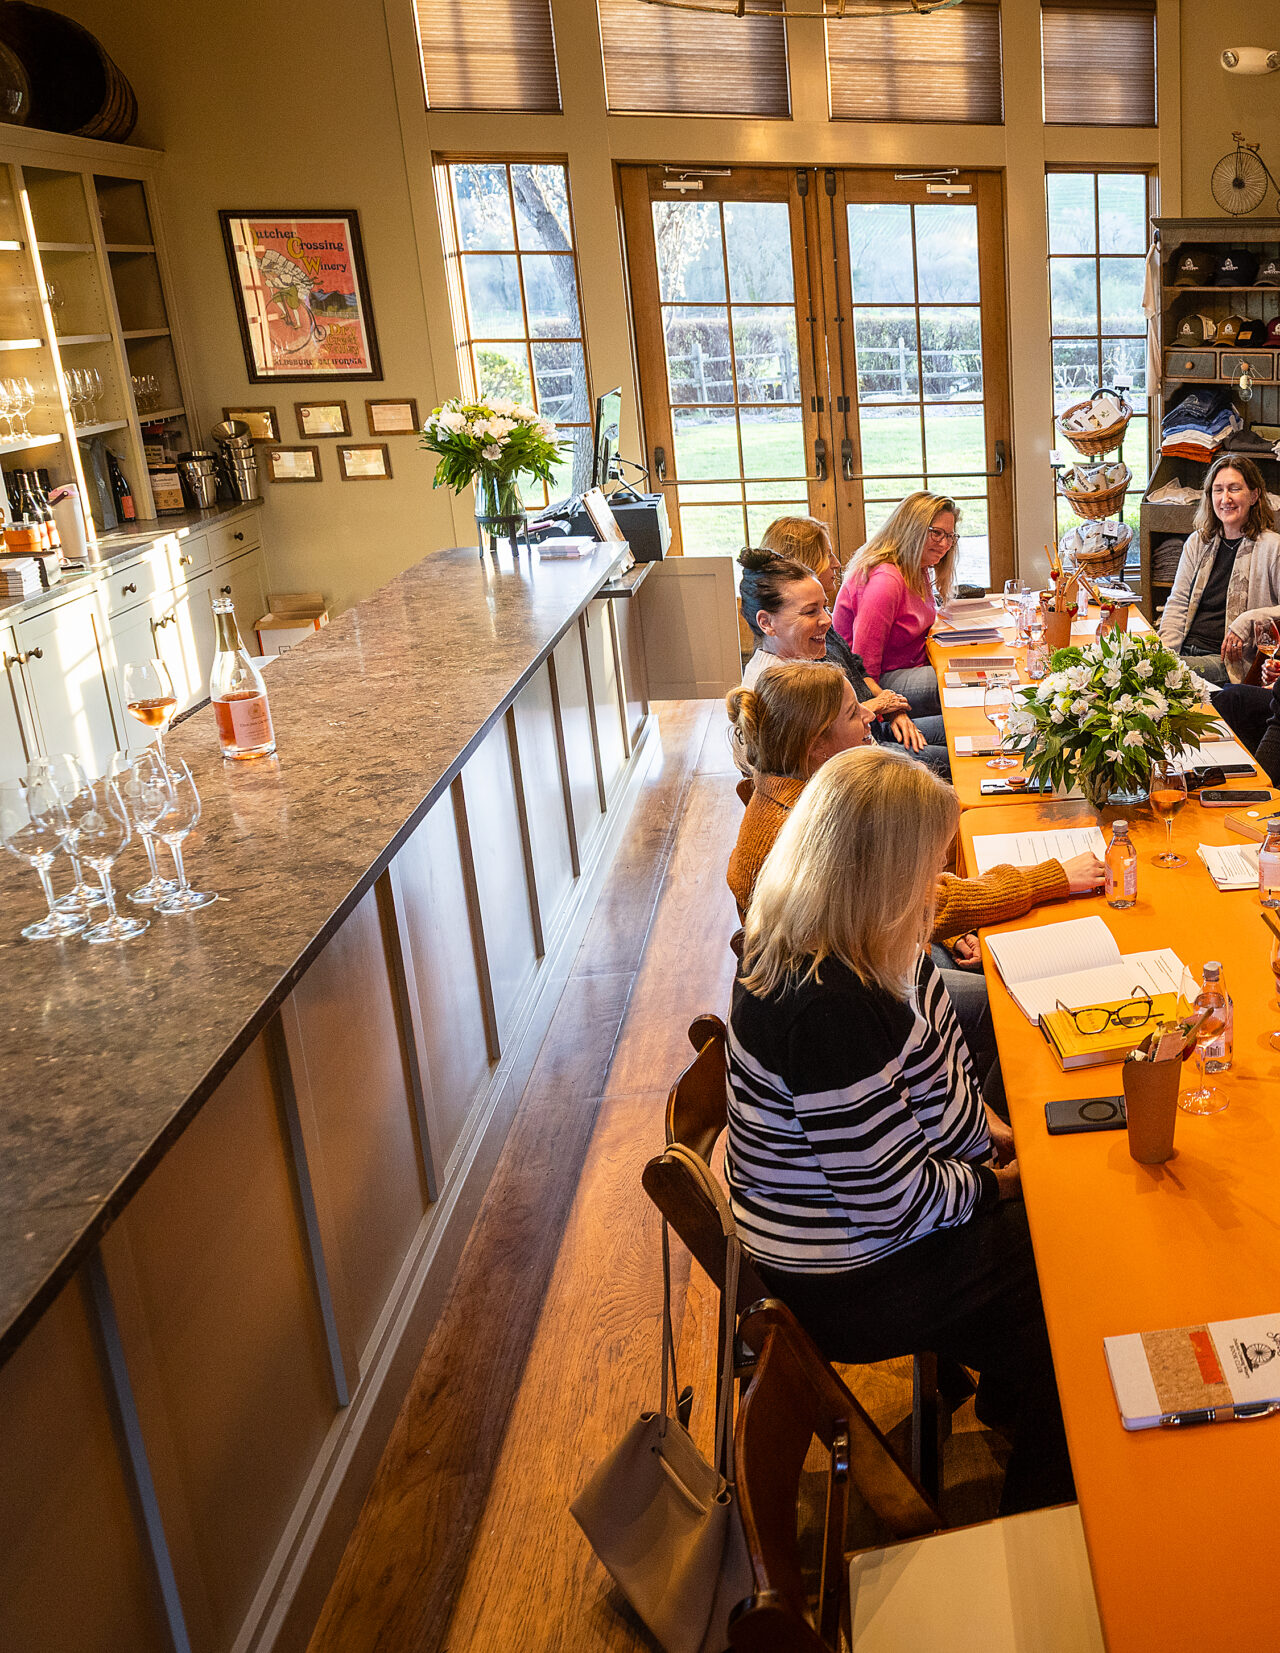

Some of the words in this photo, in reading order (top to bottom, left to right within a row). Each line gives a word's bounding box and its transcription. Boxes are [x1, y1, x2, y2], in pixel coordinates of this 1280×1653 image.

[287, 237, 344, 259] Crossing
[302, 256, 347, 275] Winery
[328, 323, 356, 336] Dry
